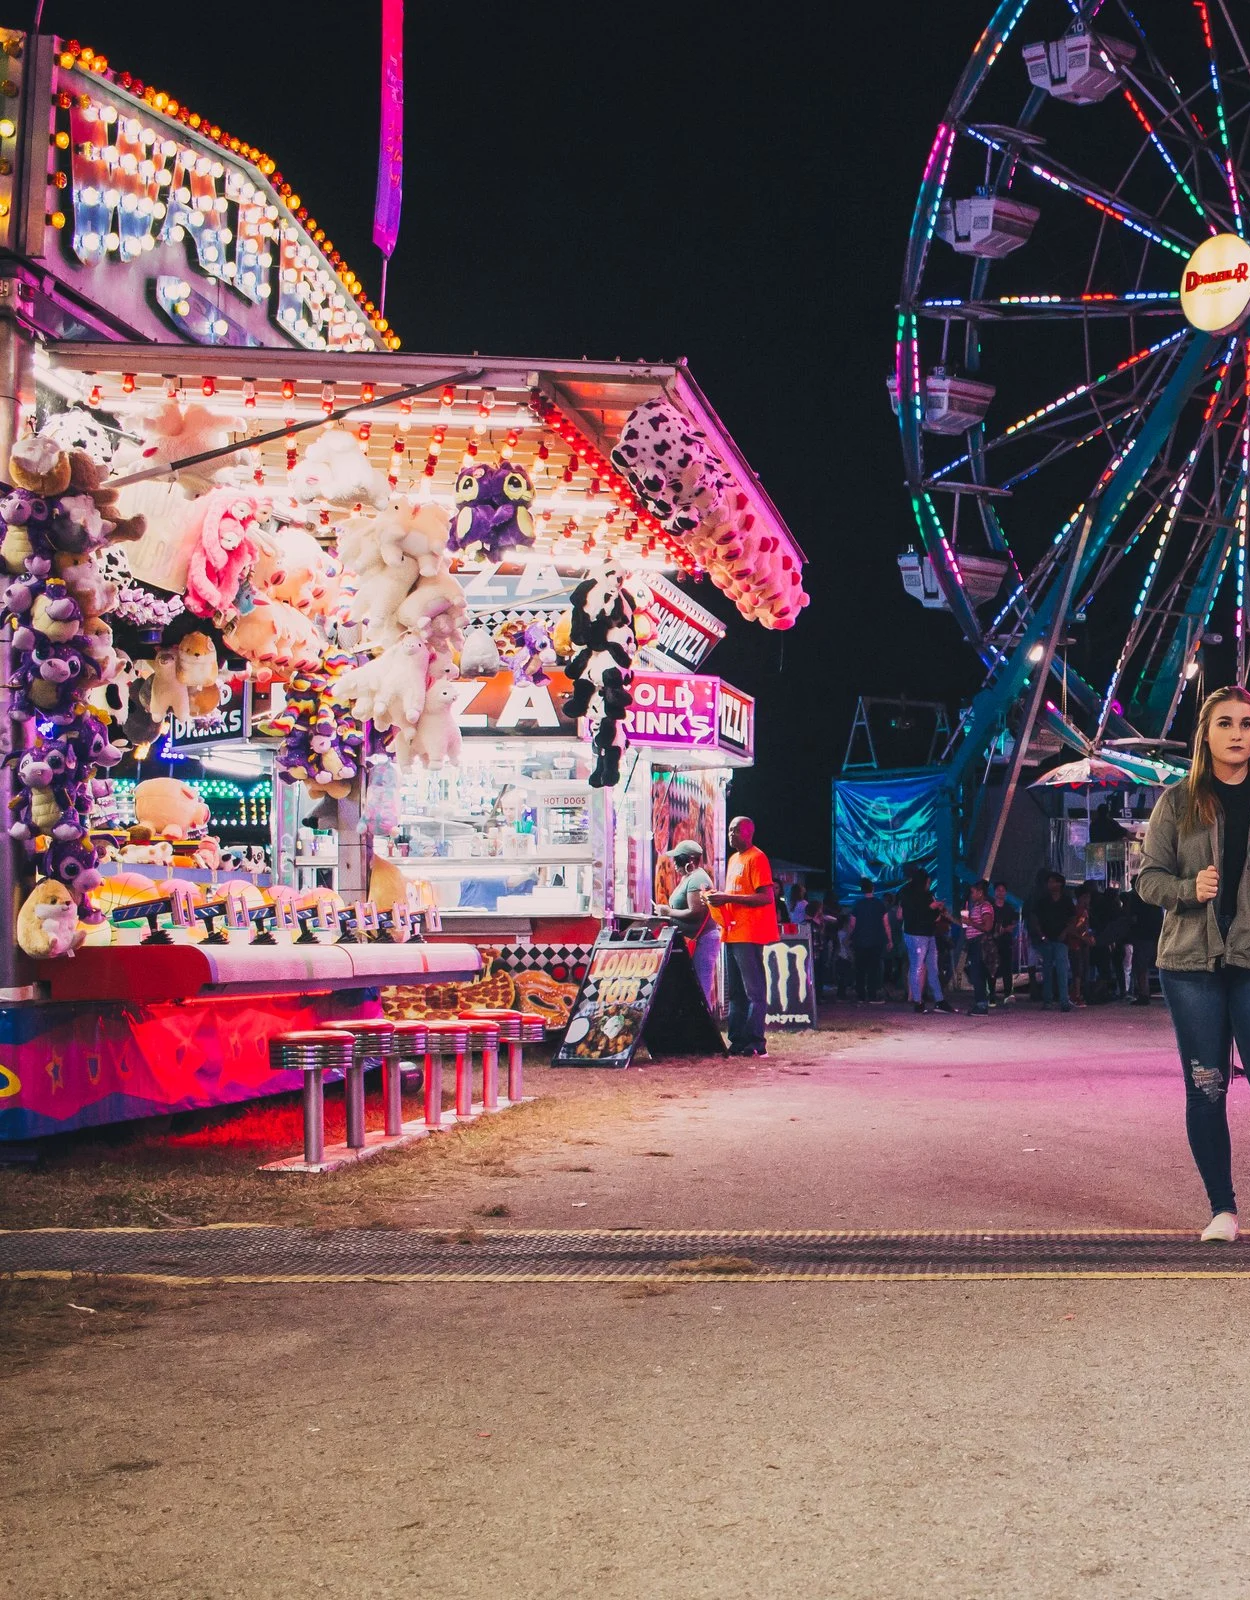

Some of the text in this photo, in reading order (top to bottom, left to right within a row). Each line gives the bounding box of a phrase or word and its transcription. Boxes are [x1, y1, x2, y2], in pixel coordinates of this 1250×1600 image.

[1071, 22, 1084, 33] 10
[669, 621, 710, 665] PIZZA
[623, 683, 695, 708] OLD
[621, 711, 714, 739] RINKS
[543, 797, 586, 805] HOT DOGS
[1119, 808, 1133, 818] 15
[593, 951, 659, 979] LOADED
[597, 979, 642, 1005] TOTS
